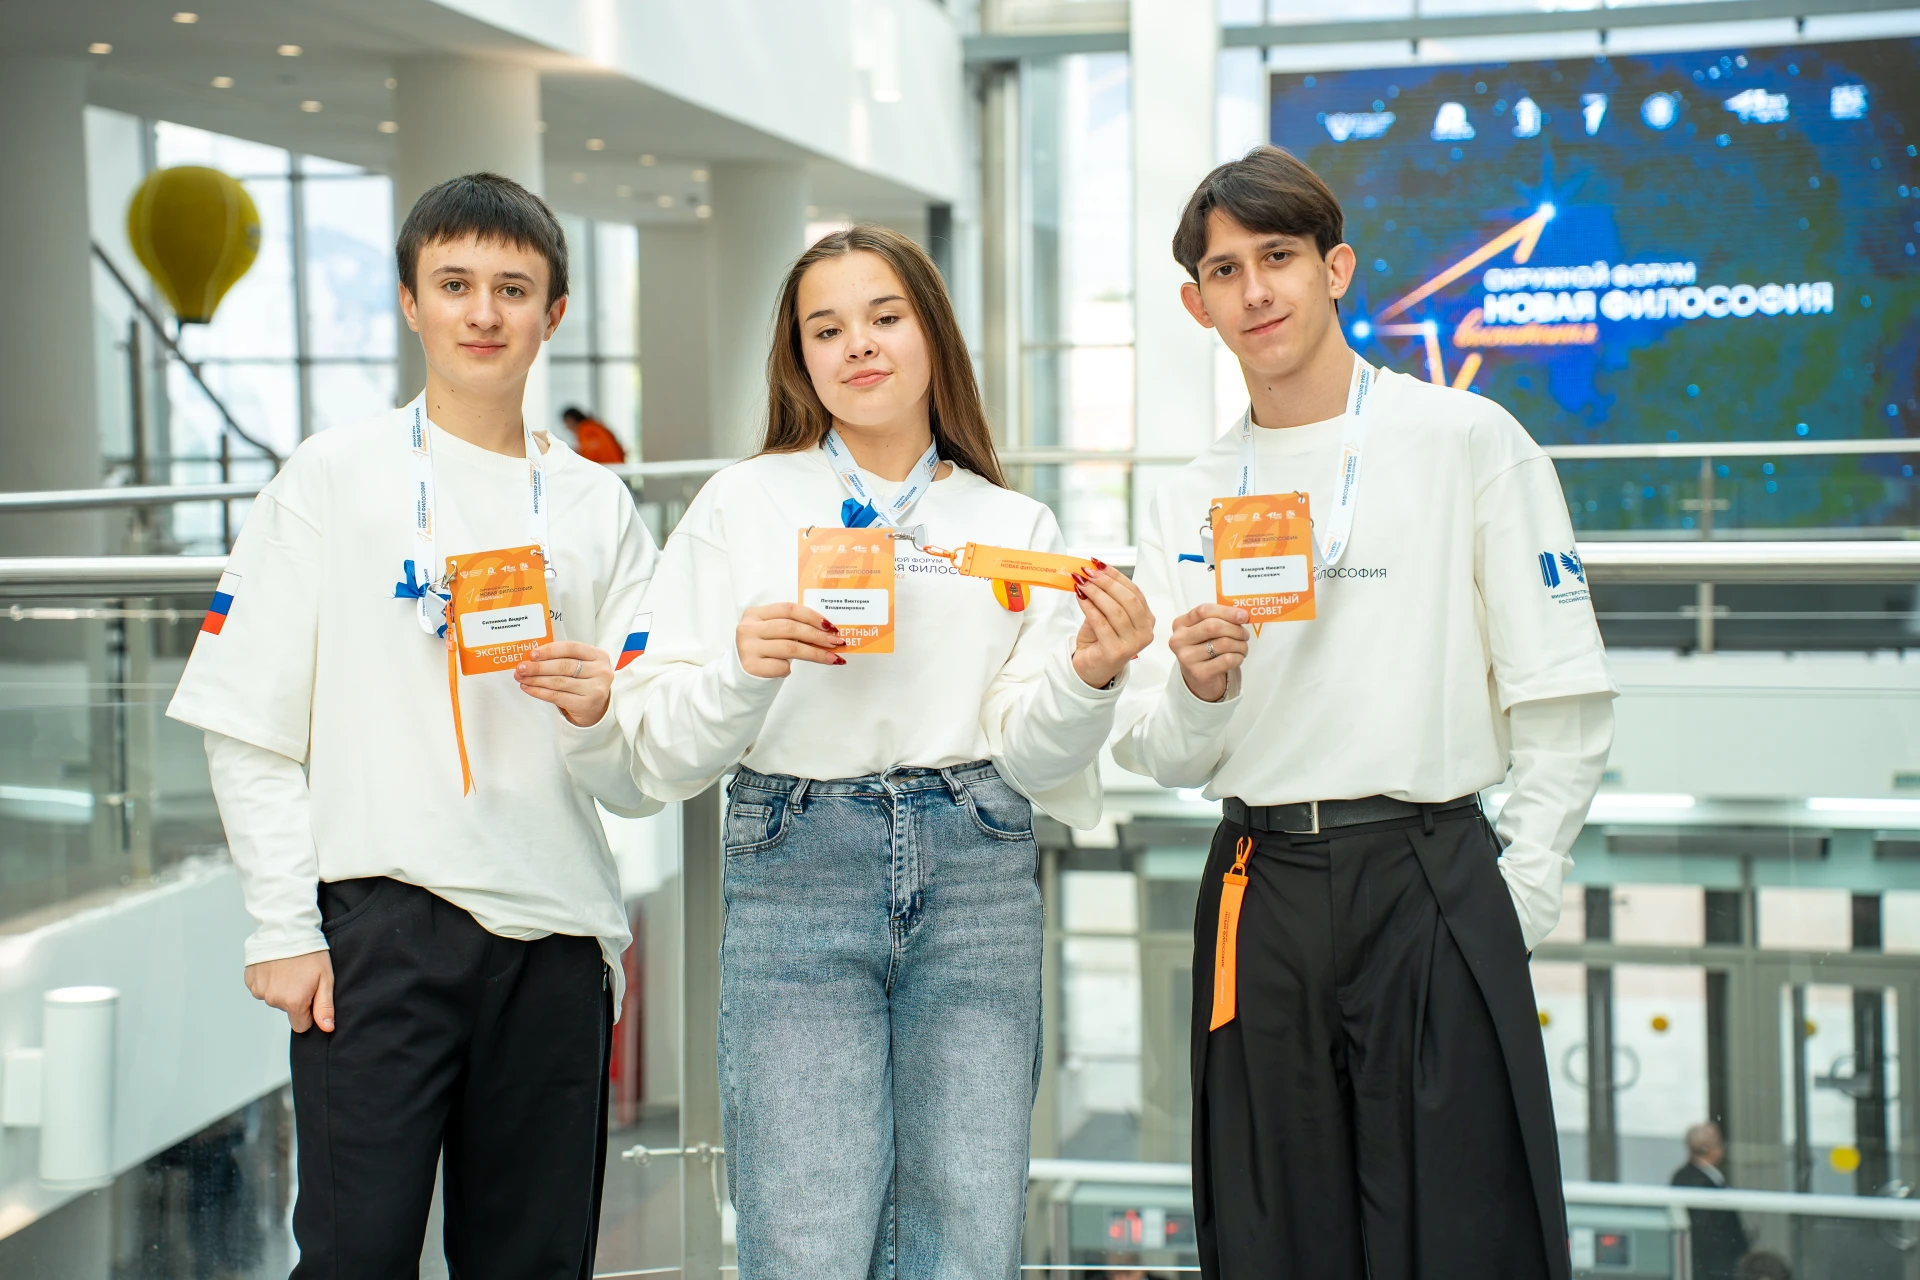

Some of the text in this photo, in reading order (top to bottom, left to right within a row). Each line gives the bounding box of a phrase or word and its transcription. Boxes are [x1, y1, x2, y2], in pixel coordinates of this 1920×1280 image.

[1482, 260, 1697, 292] ОКРУЖНОЙ ФОРУМ
[1483, 281, 1835, 325] НОВАЯ ФИЛОСОФИЯ
[1019, 565, 1057, 573] ФИЛОСОФИЯ
[498, 585, 533, 595] ФИЛОСОФИЯ
[1232, 593, 1299, 608] ЭКСПЕРТНЫЙ
[1558, 595, 1591, 604] РОССИЙСКО
[1250, 606, 1282, 616] СОВЕТ
[837, 626, 879, 637] ЕРТНЫЙ
[840, 637, 862, 646] ВЕТ
[475, 640, 540, 658] ЭКСПЕРТНЫЙ
[493, 653, 524, 665] СОВЕТ
